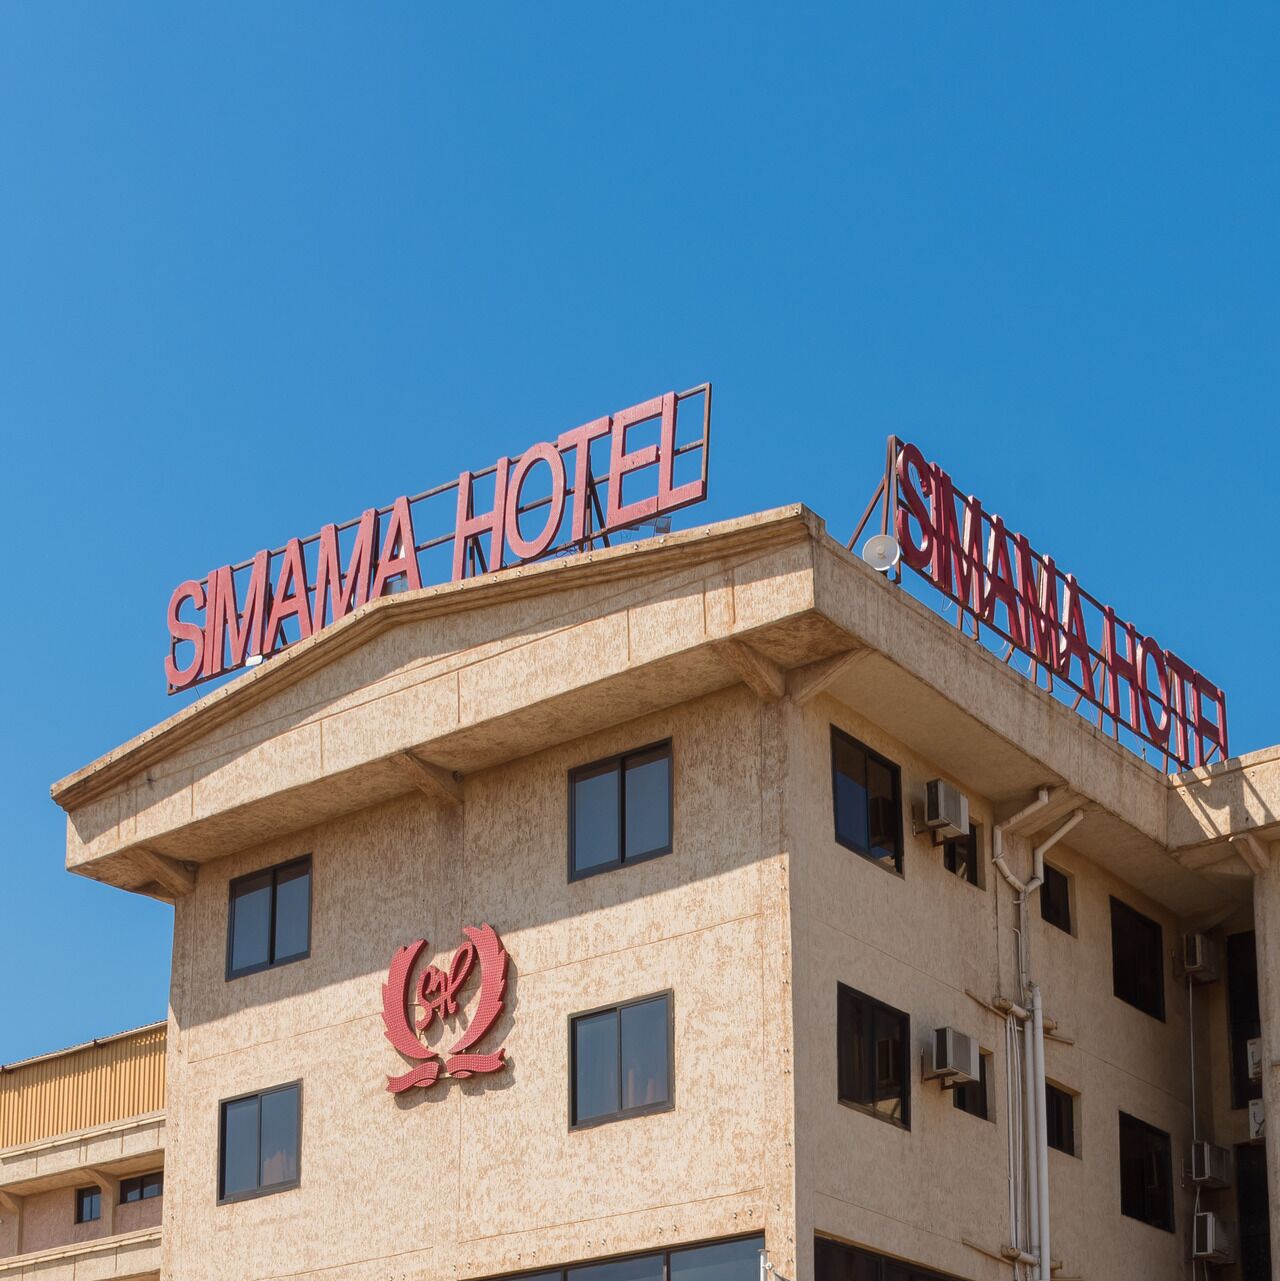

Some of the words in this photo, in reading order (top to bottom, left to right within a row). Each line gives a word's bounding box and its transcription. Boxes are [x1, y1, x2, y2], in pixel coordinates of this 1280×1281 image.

[165, 496, 422, 688] SIMAMA
[452, 391, 704, 582] HOTEL
[896, 443, 1096, 700] SIMAMA
